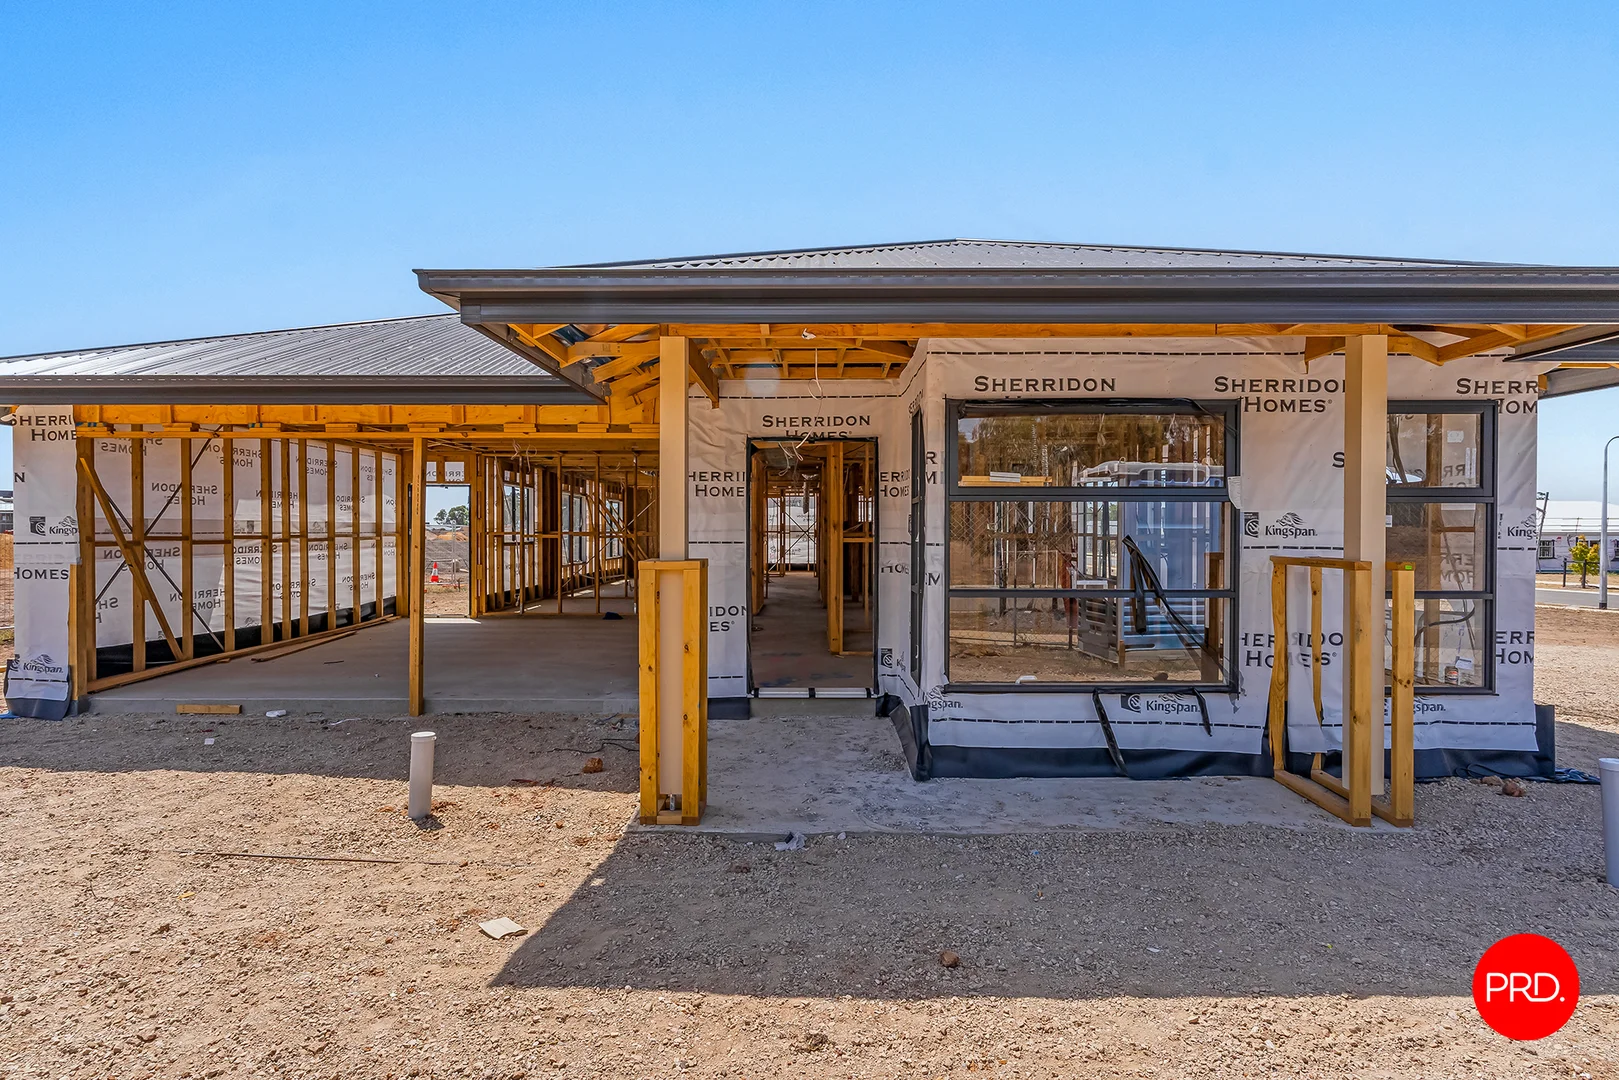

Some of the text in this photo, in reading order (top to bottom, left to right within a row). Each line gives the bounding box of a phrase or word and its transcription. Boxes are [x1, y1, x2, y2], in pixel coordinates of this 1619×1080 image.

[974, 375, 1117, 392] SHERRIDON
[1214, 376, 1345, 393] SHERRIDO
[762, 415, 871, 427] SHERRIDON
[695, 484, 745, 497] HOME
